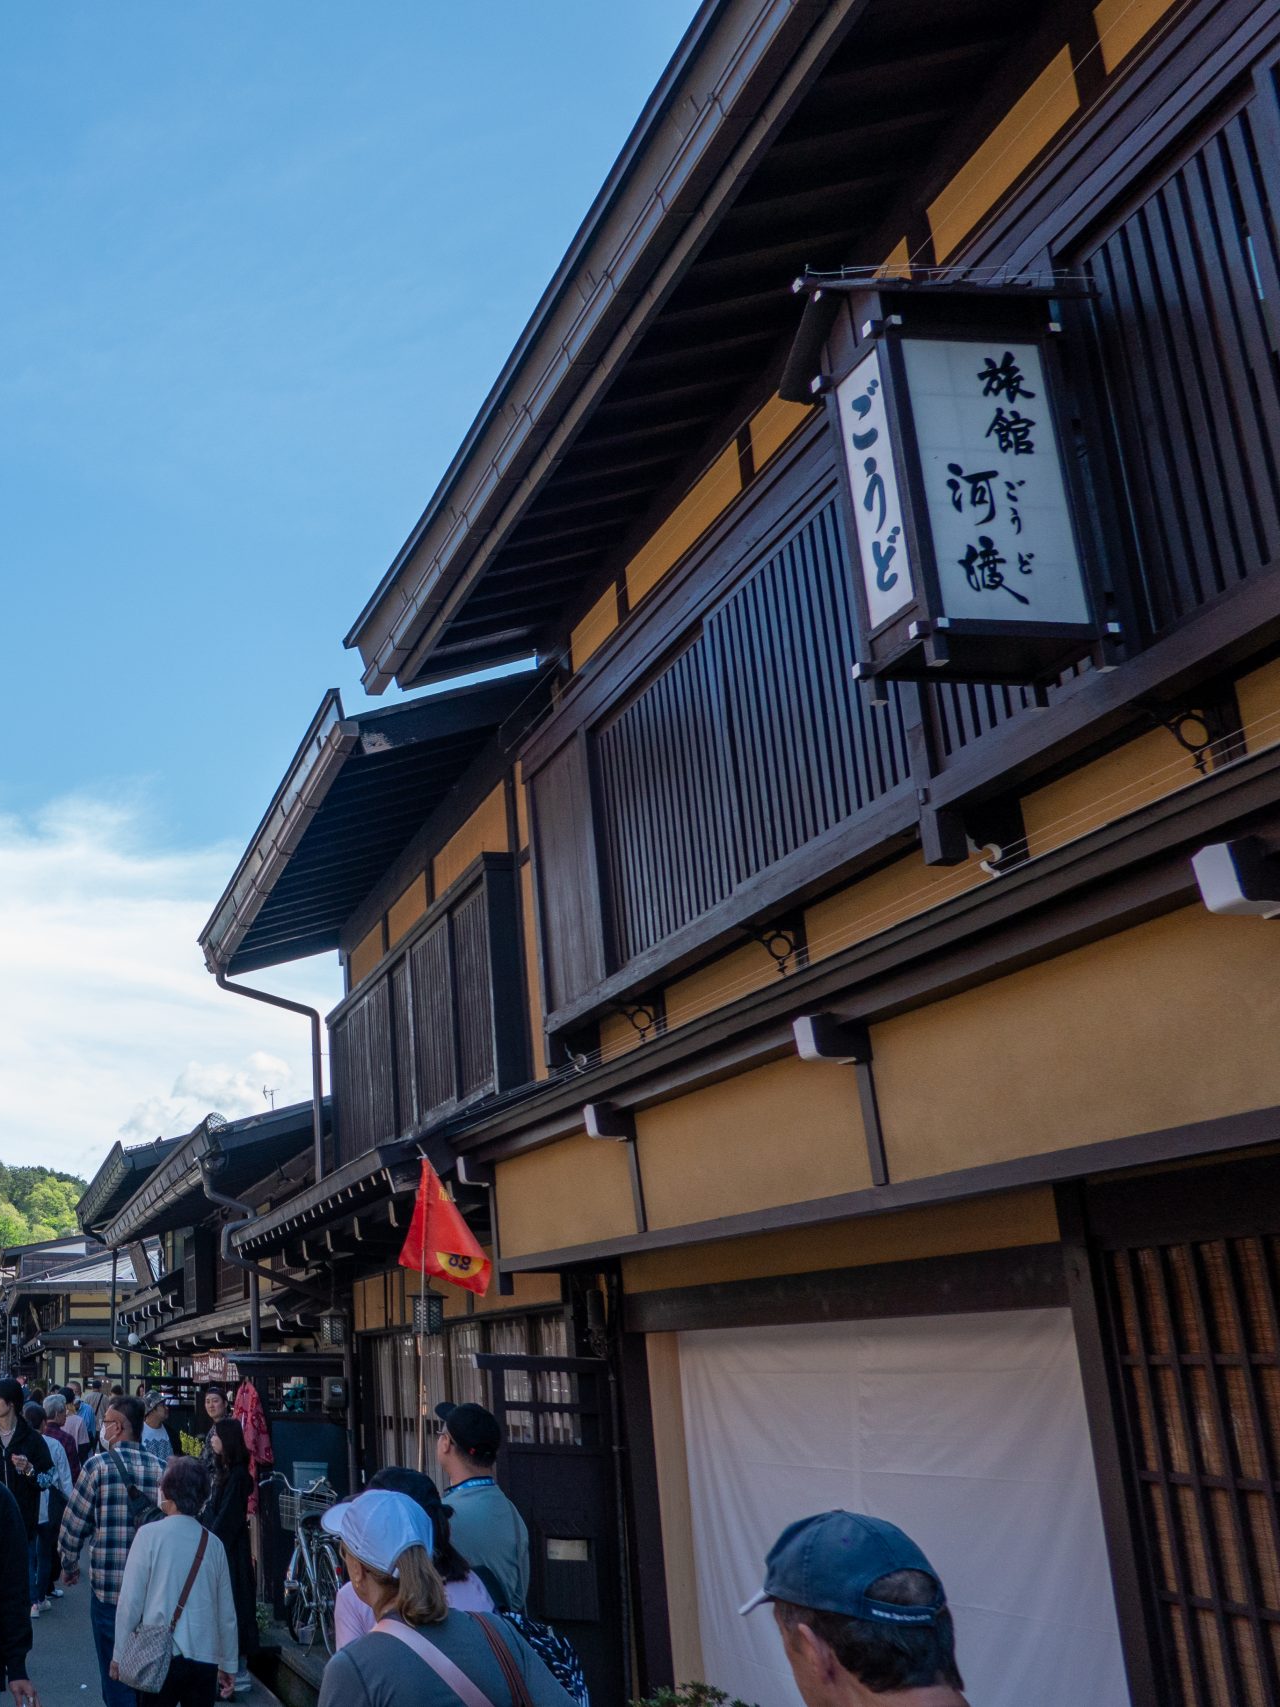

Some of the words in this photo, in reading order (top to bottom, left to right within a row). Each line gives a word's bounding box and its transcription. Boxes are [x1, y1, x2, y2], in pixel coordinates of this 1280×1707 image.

[977, 351, 1036, 455] 旅館
[851, 379, 902, 592] ごうど
[1004, 480, 1036, 576] ごうど
